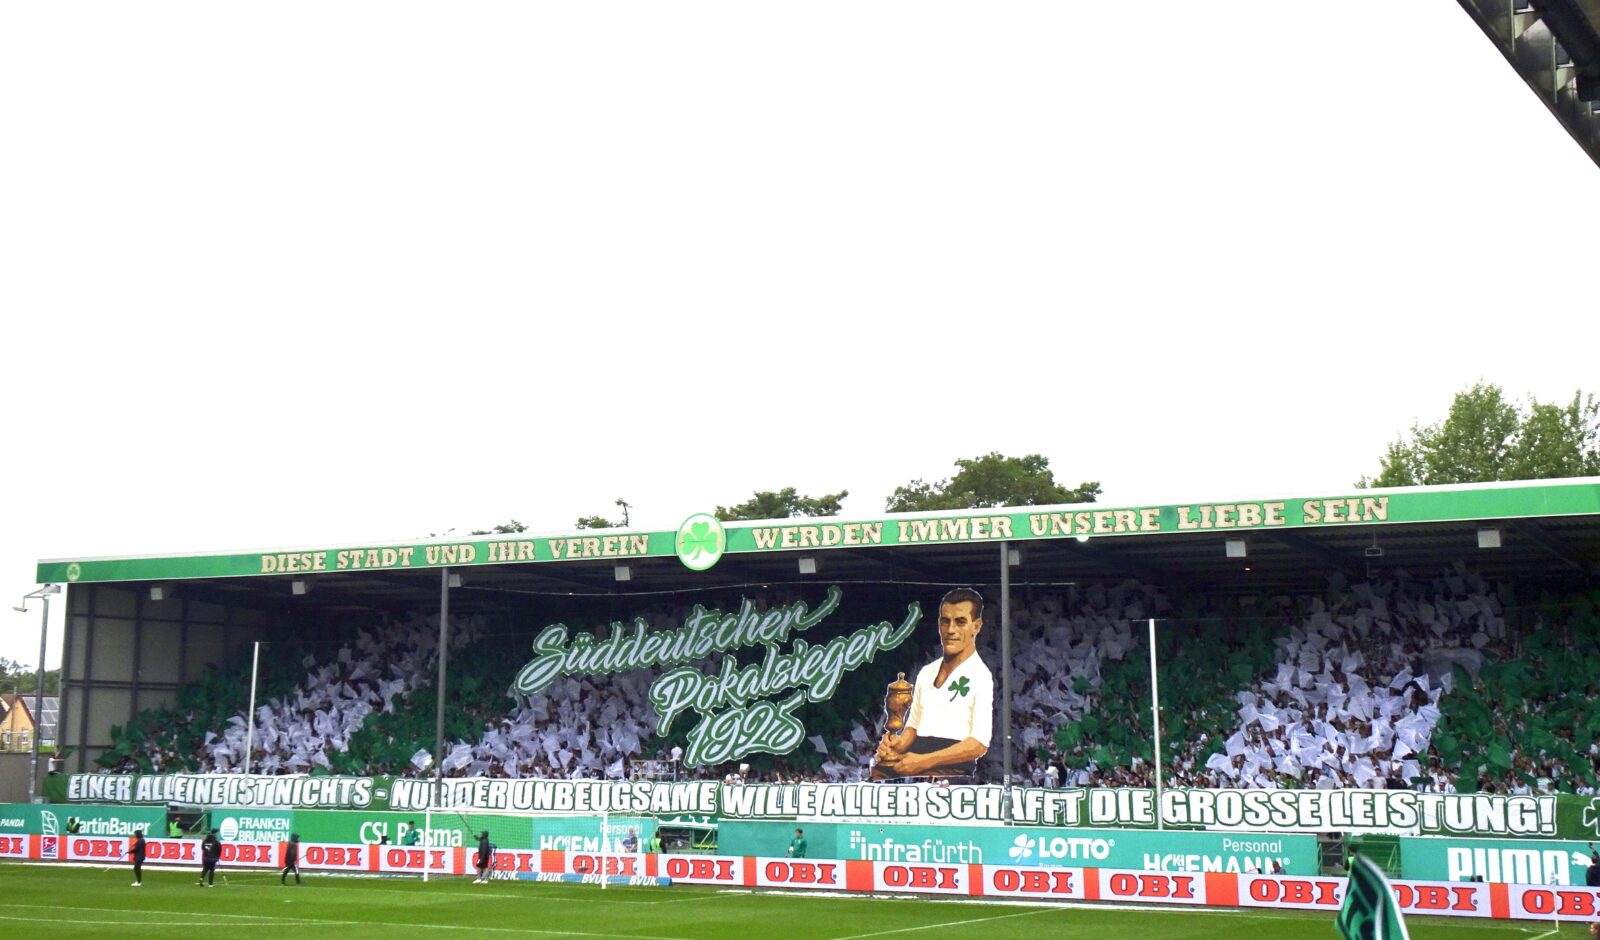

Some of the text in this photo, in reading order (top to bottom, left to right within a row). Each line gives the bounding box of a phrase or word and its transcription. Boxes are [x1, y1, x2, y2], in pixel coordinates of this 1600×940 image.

[261, 497, 1389, 573] DIESE STADT UND IHR VEREIN WERDEN IMMER UNSERE LIEBE SEIN
[515, 586, 842, 694] Süddeutscher
[650, 602, 922, 737] Pokalsieger
[684, 693, 805, 767] 1925
[68, 774, 132, 802] EINER
[135, 775, 228, 805] ALLEINE
[228, 777, 274, 806] IST
[274, 777, 373, 808] NICHTS
[391, 780, 449, 810] NUR
[453, 780, 509, 809] DER
[513, 780, 718, 813] UNBEUGSAME
[722, 783, 817, 817] WILLE
[821, 785, 919, 817] ALLER
[926, 786, 1085, 824] SCHAFFT
[1089, 789, 1155, 825] DIE
[1161, 789, 1322, 827] GROSSE
[1329, 790, 1557, 835] LEISTUNG!
[239, 817, 290, 831] FRANKEN
[239, 830, 289, 842] BRUNNEN
[360, 821, 462, 847] CSL Pasma
[0, 837, 23, 854] BI
[73, 839, 122, 857] OBI
[145, 841, 196, 860] OBI
[220, 844, 272, 862] OBI
[306, 847, 362, 866] OBI
[861, 837, 982, 864] infrafürth
[1039, 836, 1110, 860] LOTTO
[1223, 838, 1281, 853] Personal
[387, 849, 445, 869] OBI
[573, 855, 637, 876] OBI
[667, 858, 734, 880] OBI
[1447, 847, 1570, 885] PUMA
[765, 861, 836, 884] OBI
[883, 865, 958, 889] OBI
[993, 870, 1073, 893] OBI
[1110, 873, 1194, 898] OBI
[1250, 879, 1339, 905] OBI
[1391, 884, 1477, 911] OBI
[1522, 890, 1600, 916] OB
